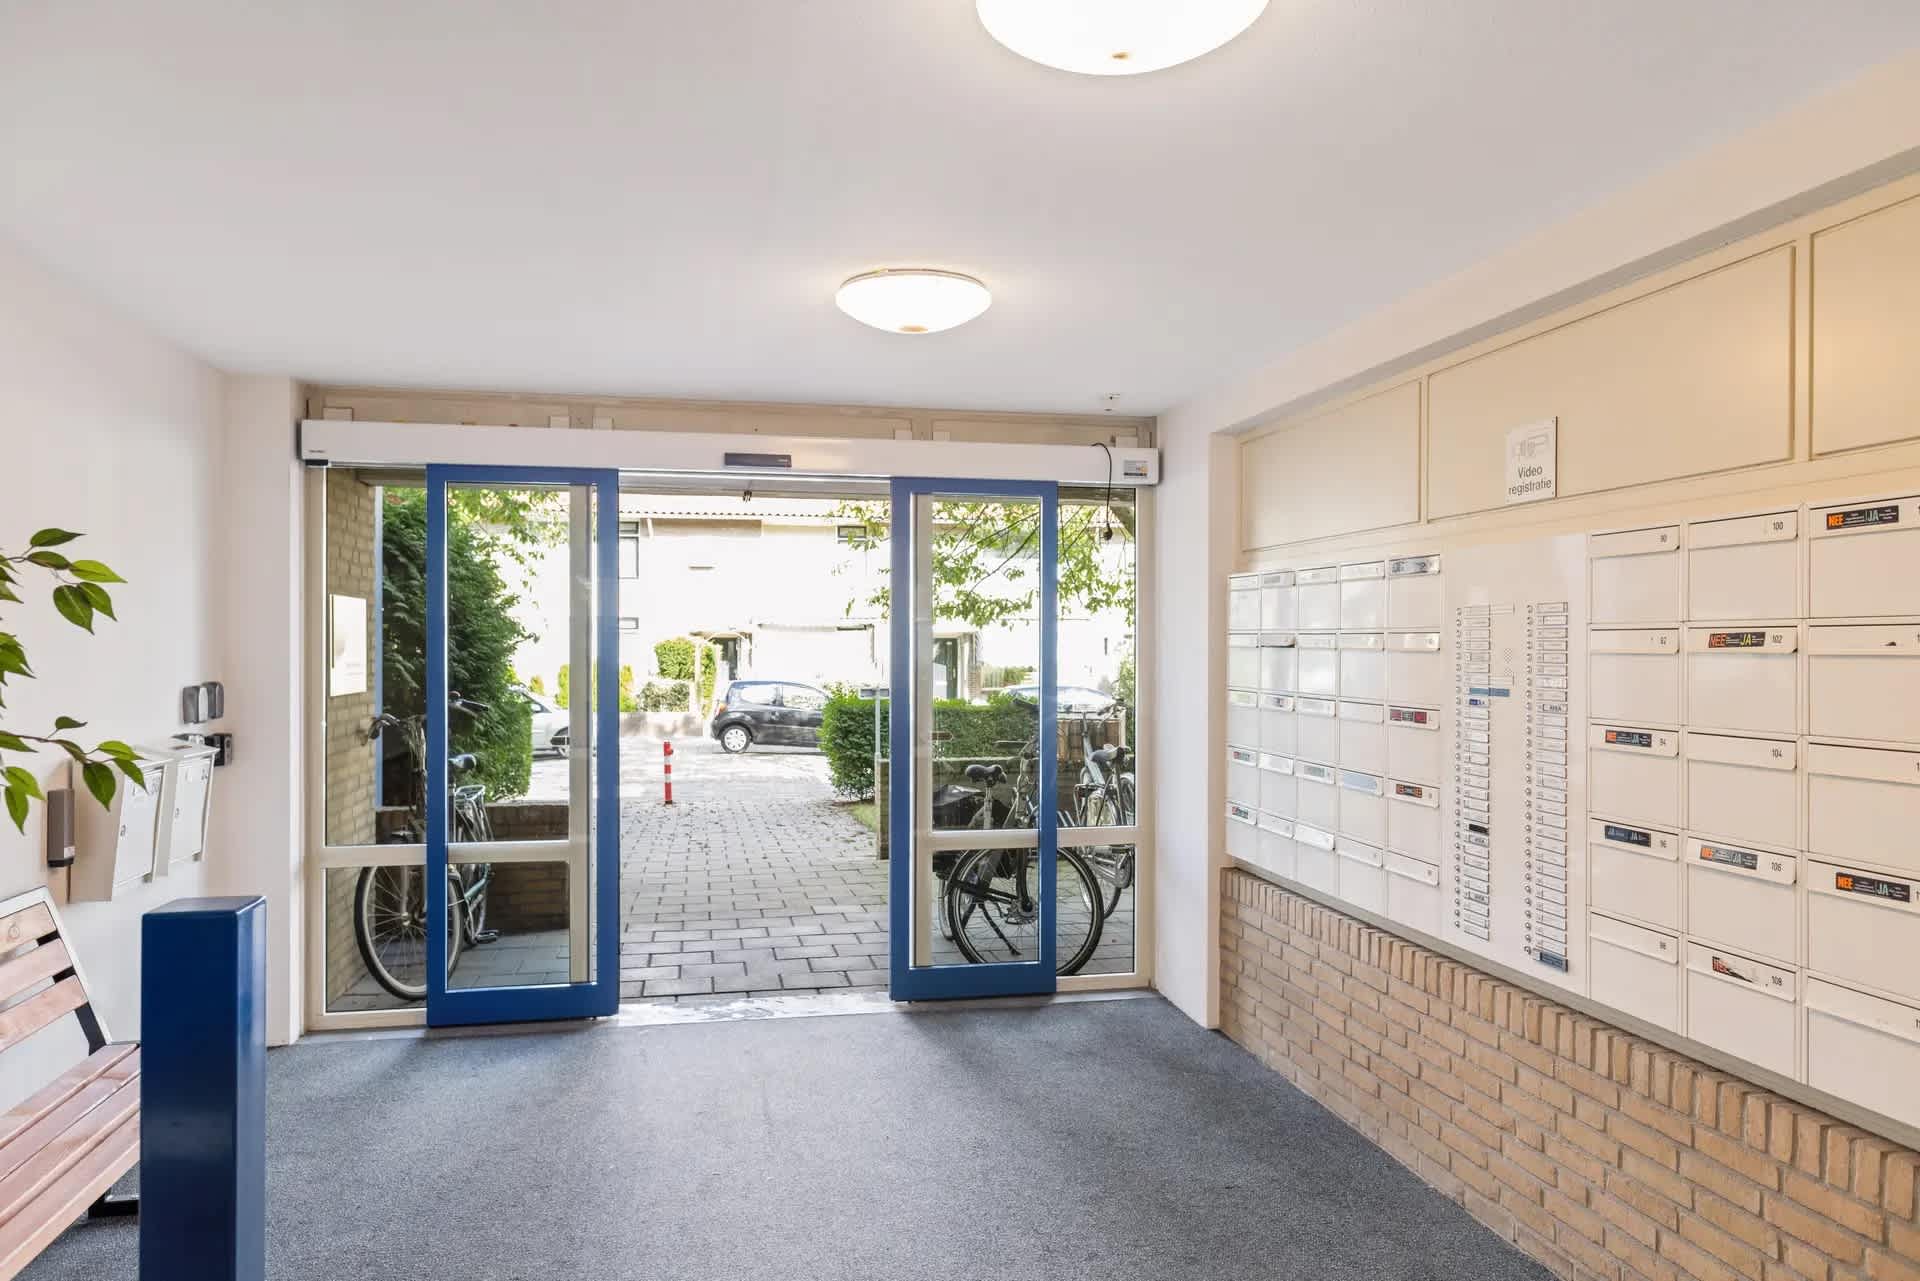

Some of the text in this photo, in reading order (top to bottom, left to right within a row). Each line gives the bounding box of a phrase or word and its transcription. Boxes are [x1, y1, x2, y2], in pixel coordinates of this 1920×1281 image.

[1517, 465, 1543, 479] Video
[1508, 478, 1552, 496] registratie
[1828, 514, 1845, 527] NEE
[1740, 633, 1752, 646] JA
